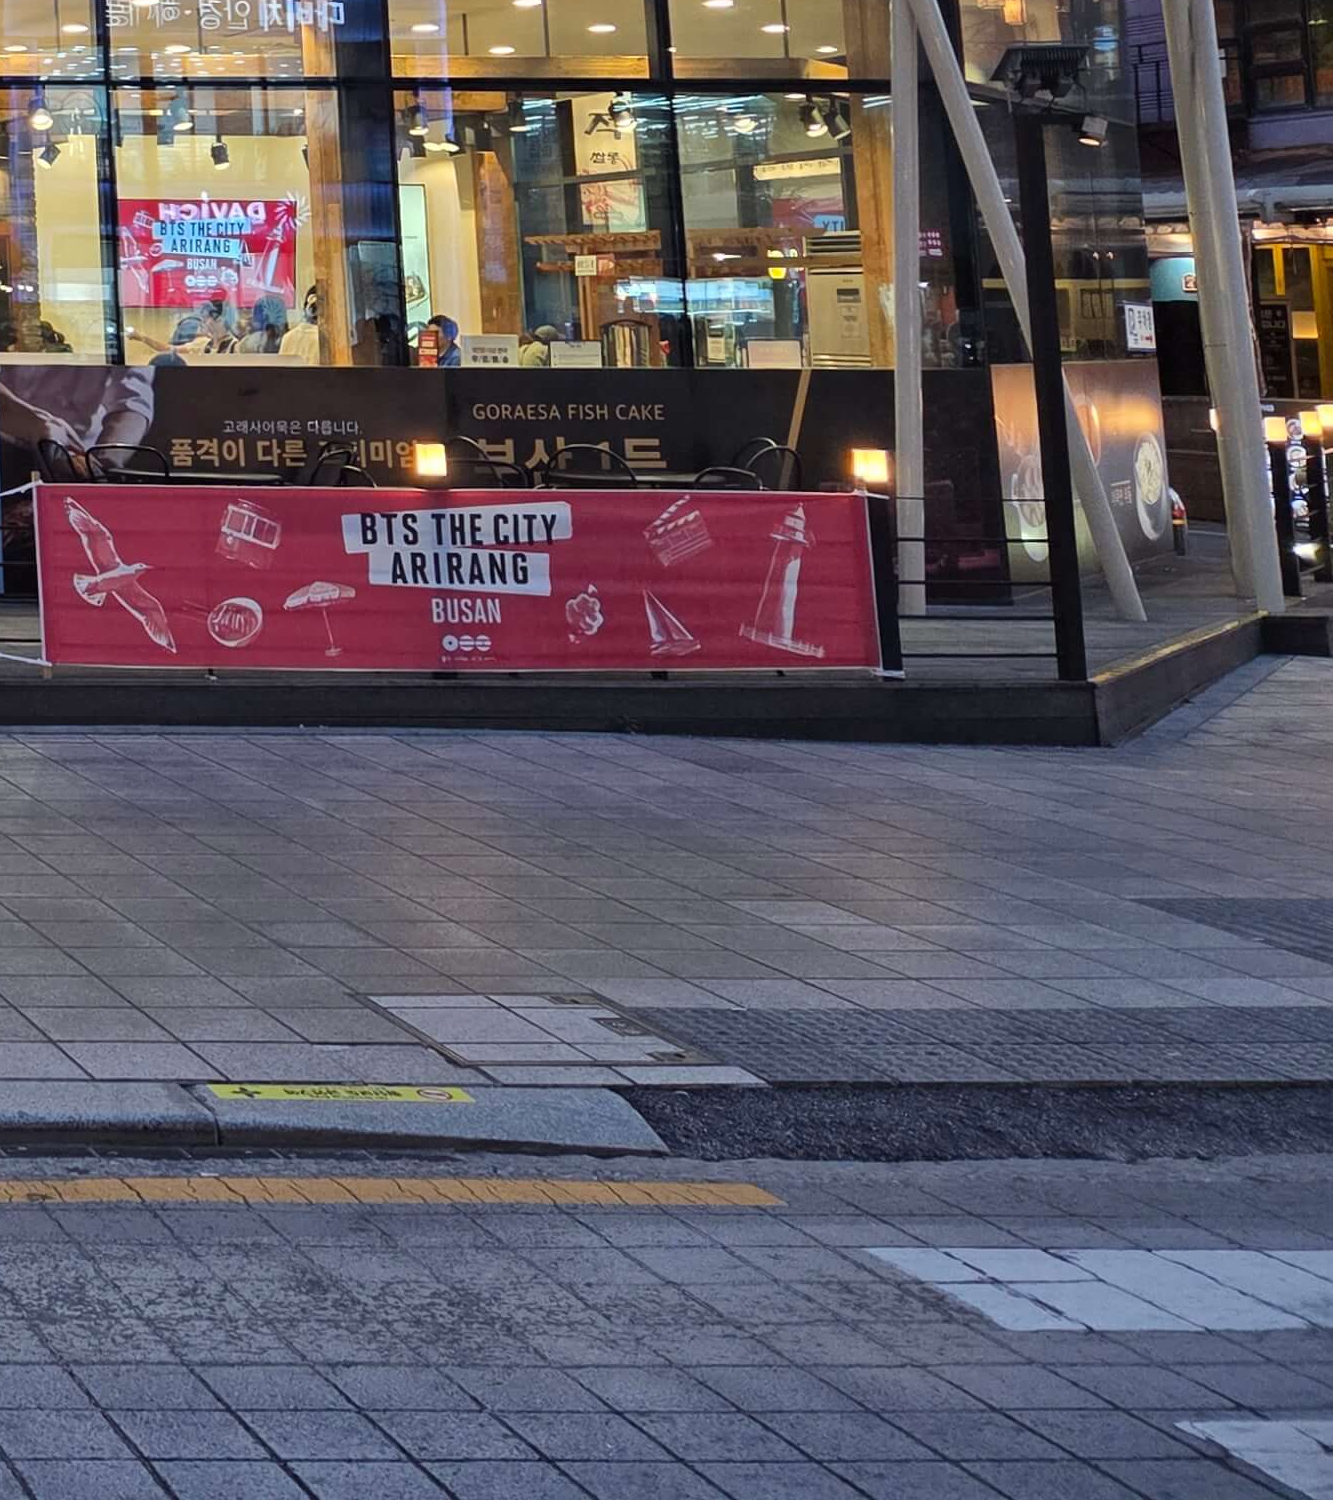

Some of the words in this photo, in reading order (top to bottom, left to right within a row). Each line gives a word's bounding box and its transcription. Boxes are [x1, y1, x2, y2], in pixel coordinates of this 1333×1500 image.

[160, 222, 184, 236] BTS
[191, 222, 213, 236] THE
[216, 222, 245, 237] CITY
[171, 238, 231, 253] ARIRANG
[472, 403, 562, 421] GORAESA
[568, 404, 609, 420] FISH
[615, 404, 665, 420] CAKE
[223, 420, 302, 435] 고래사어묵은
[307, 420, 363, 436] 다릅니다.
[169, 438, 245, 468] 품격이
[256, 438, 309, 468] 다른
[360, 512, 419, 546] BTS
[431, 513, 484, 546] THE
[493, 513, 557, 546] CITY
[391, 552, 529, 585] ARIRANG
[431, 598, 502, 624] BUSAN
